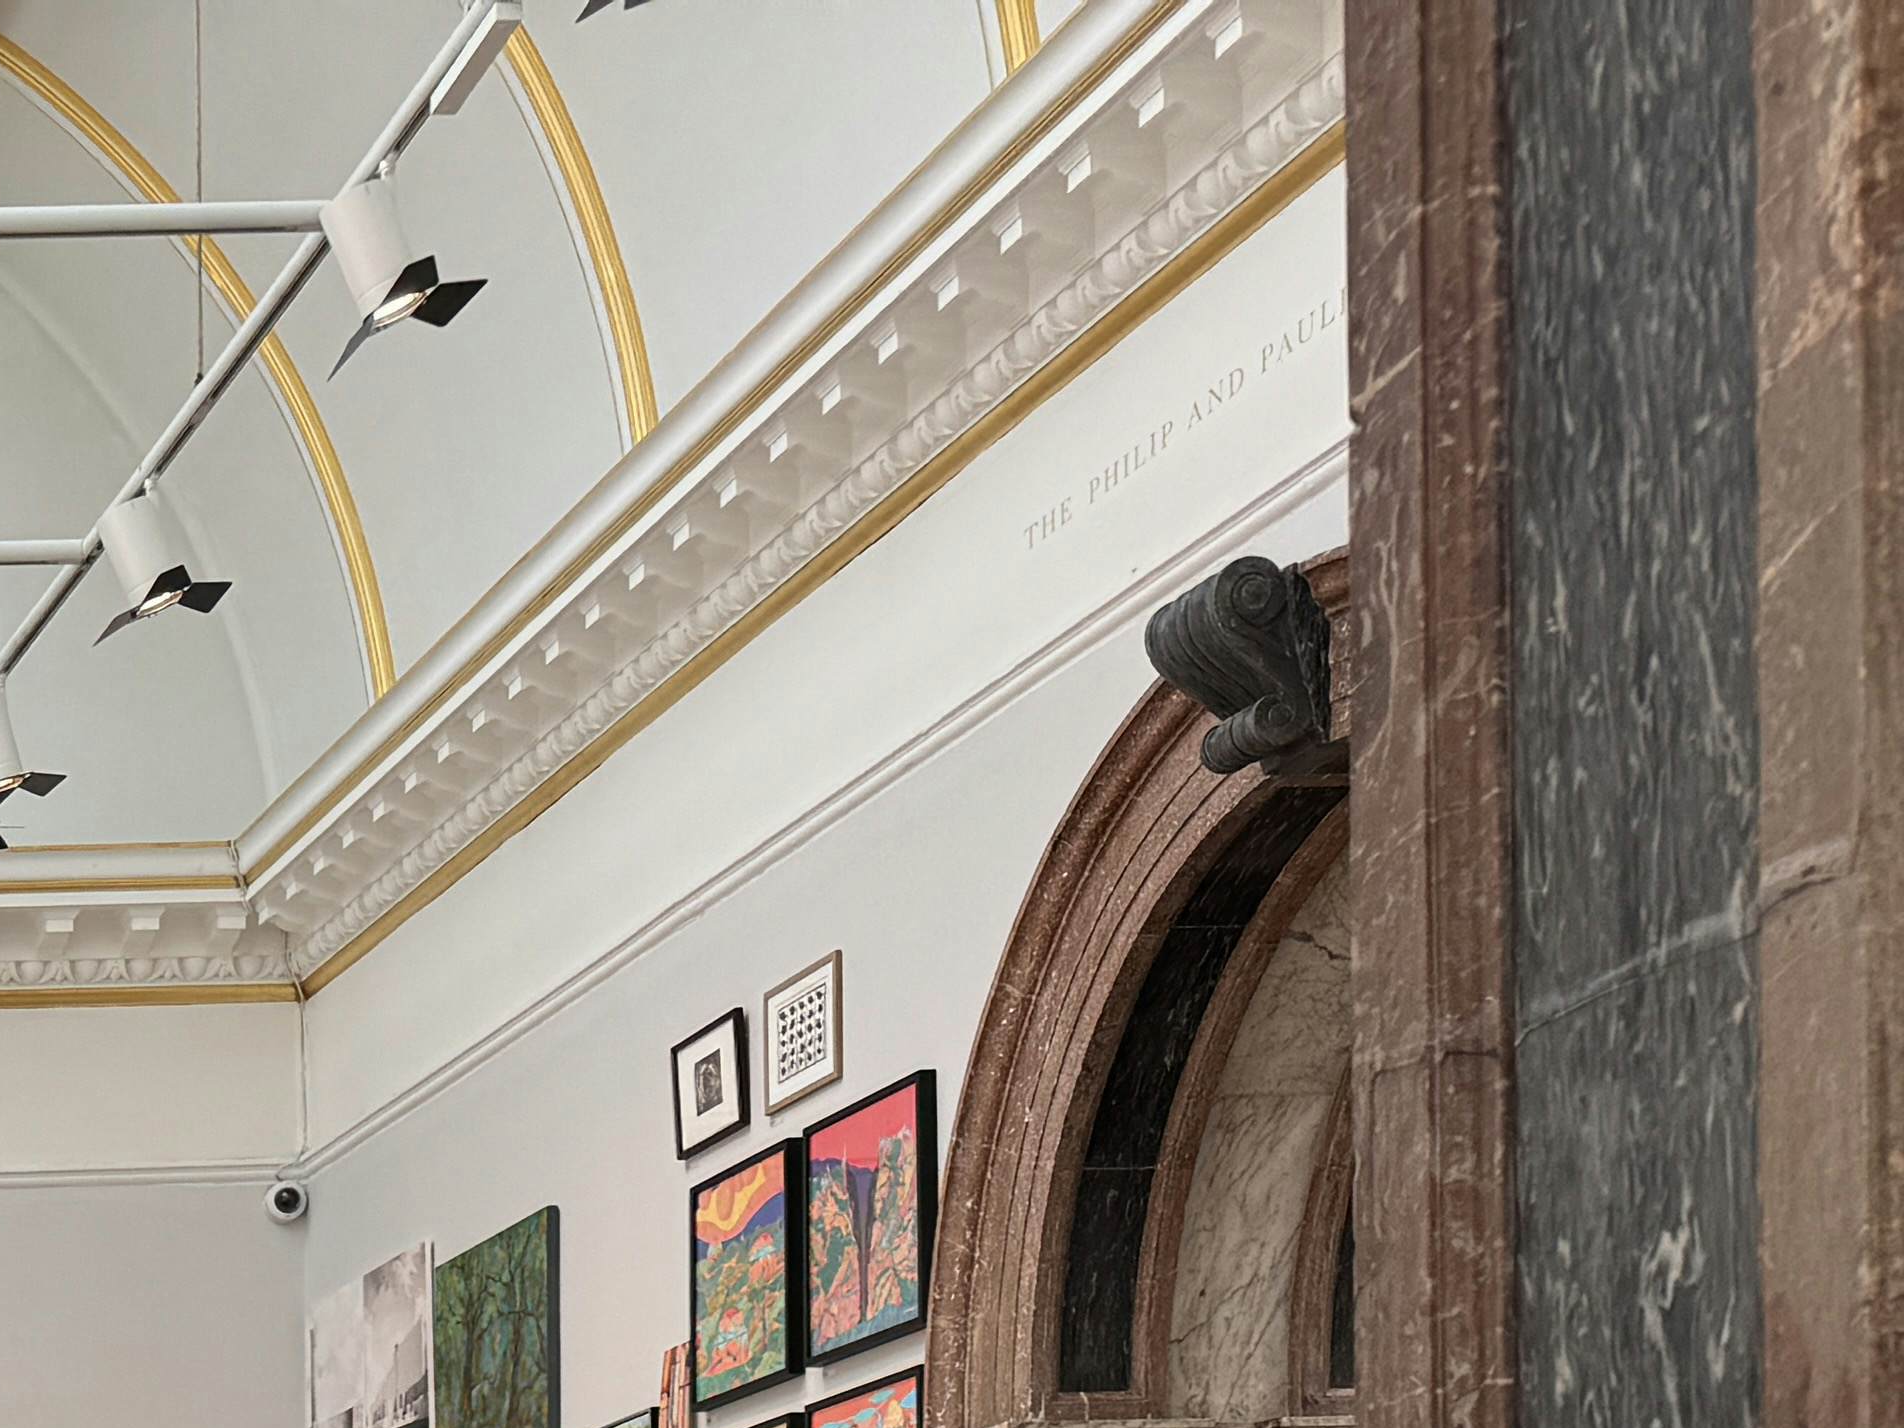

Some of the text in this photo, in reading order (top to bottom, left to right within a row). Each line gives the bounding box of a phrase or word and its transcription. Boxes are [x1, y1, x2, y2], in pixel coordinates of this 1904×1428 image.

[1023, 497, 1072, 549] THE
[1089, 421, 1174, 504] PHILIP
[1187, 367, 1245, 432] AND
